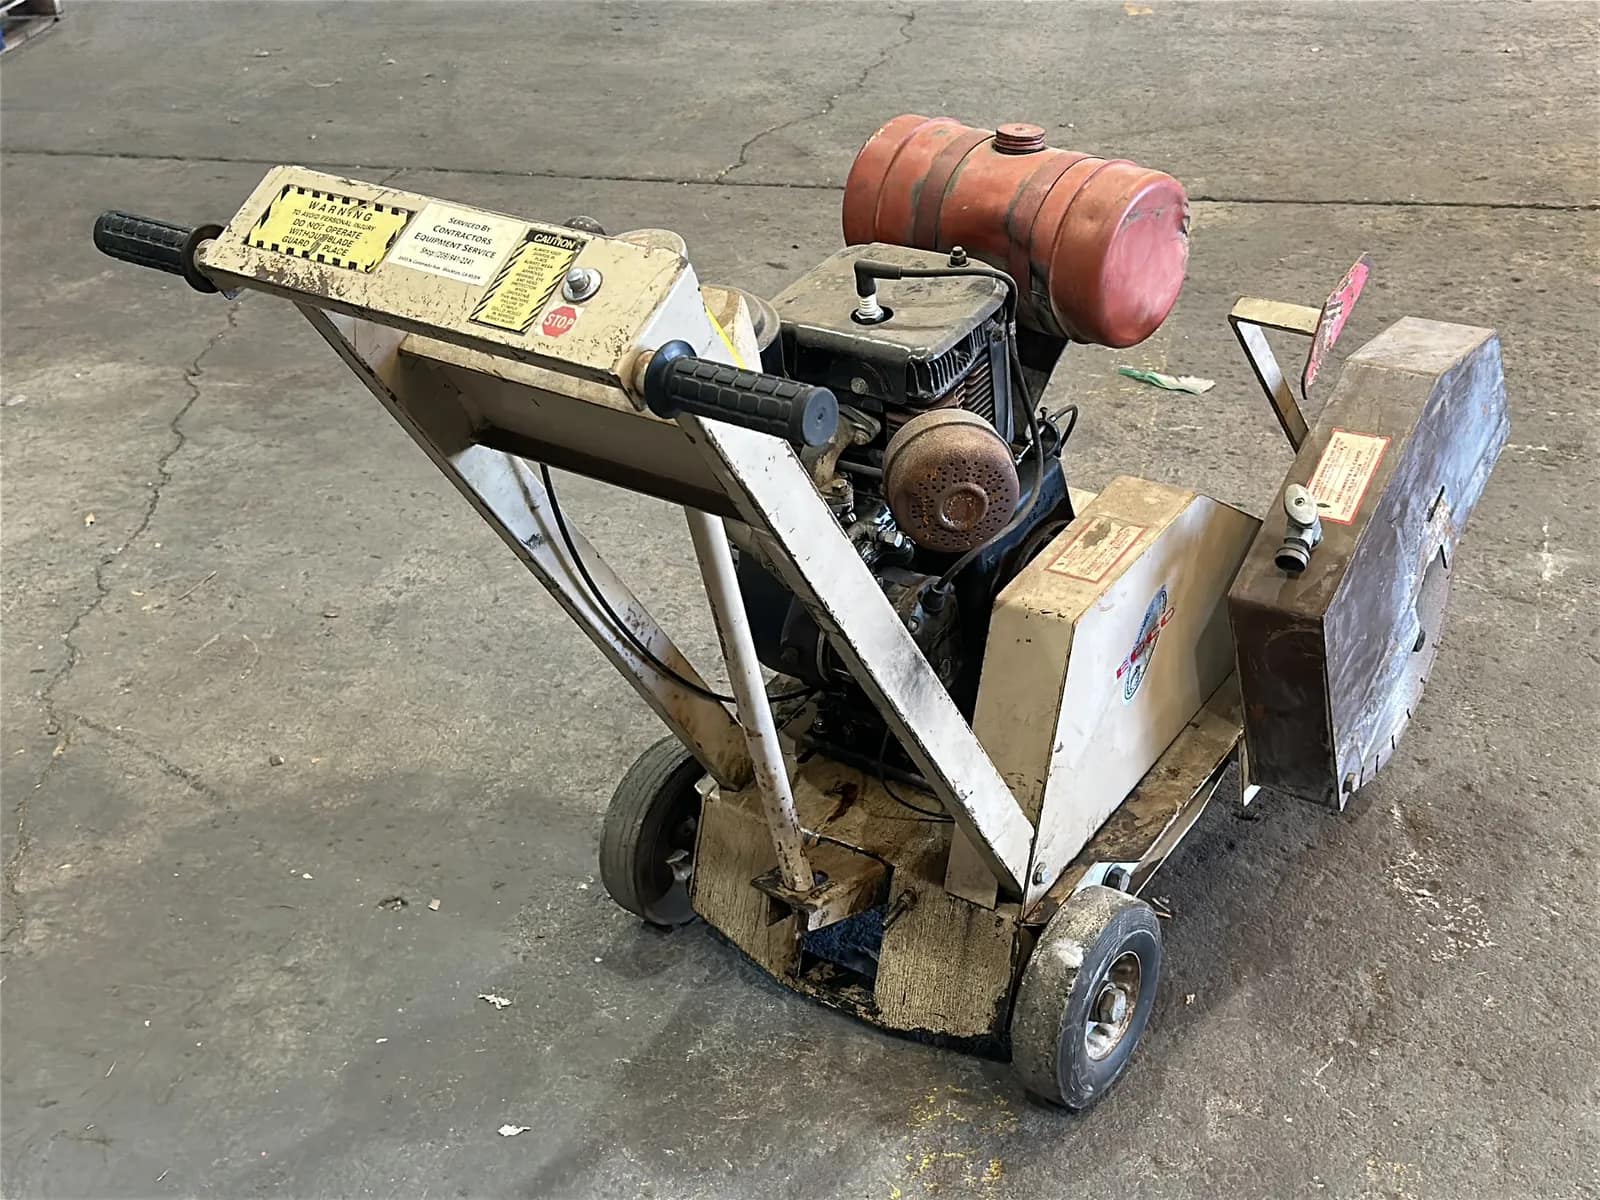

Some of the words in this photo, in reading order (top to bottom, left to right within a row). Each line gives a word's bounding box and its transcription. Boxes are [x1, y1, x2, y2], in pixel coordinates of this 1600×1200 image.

[302, 211, 319, 220] AVOID
[319, 214, 351, 227] PERSONAL
[308, 201, 373, 222] WARNING
[293, 218, 305, 227] DO
[307, 222, 326, 231] NOT
[325, 225, 363, 240] OPERATE
[448, 217, 481, 230] SERVICED
[480, 224, 491, 232] BY
[282, 235, 310, 247] GUARD
[322, 244, 350, 257] PLACE
[327, 235, 355, 248] BLADE
[414, 232, 462, 250] EQUIPMENT
[461, 244, 497, 259] SERVICE
[433, 225, 493, 246] CONTRACTORS
[534, 233, 576, 250] CAUTION
[544, 313, 576, 329] STOP
[1116, 607, 1175, 680] EDCO
